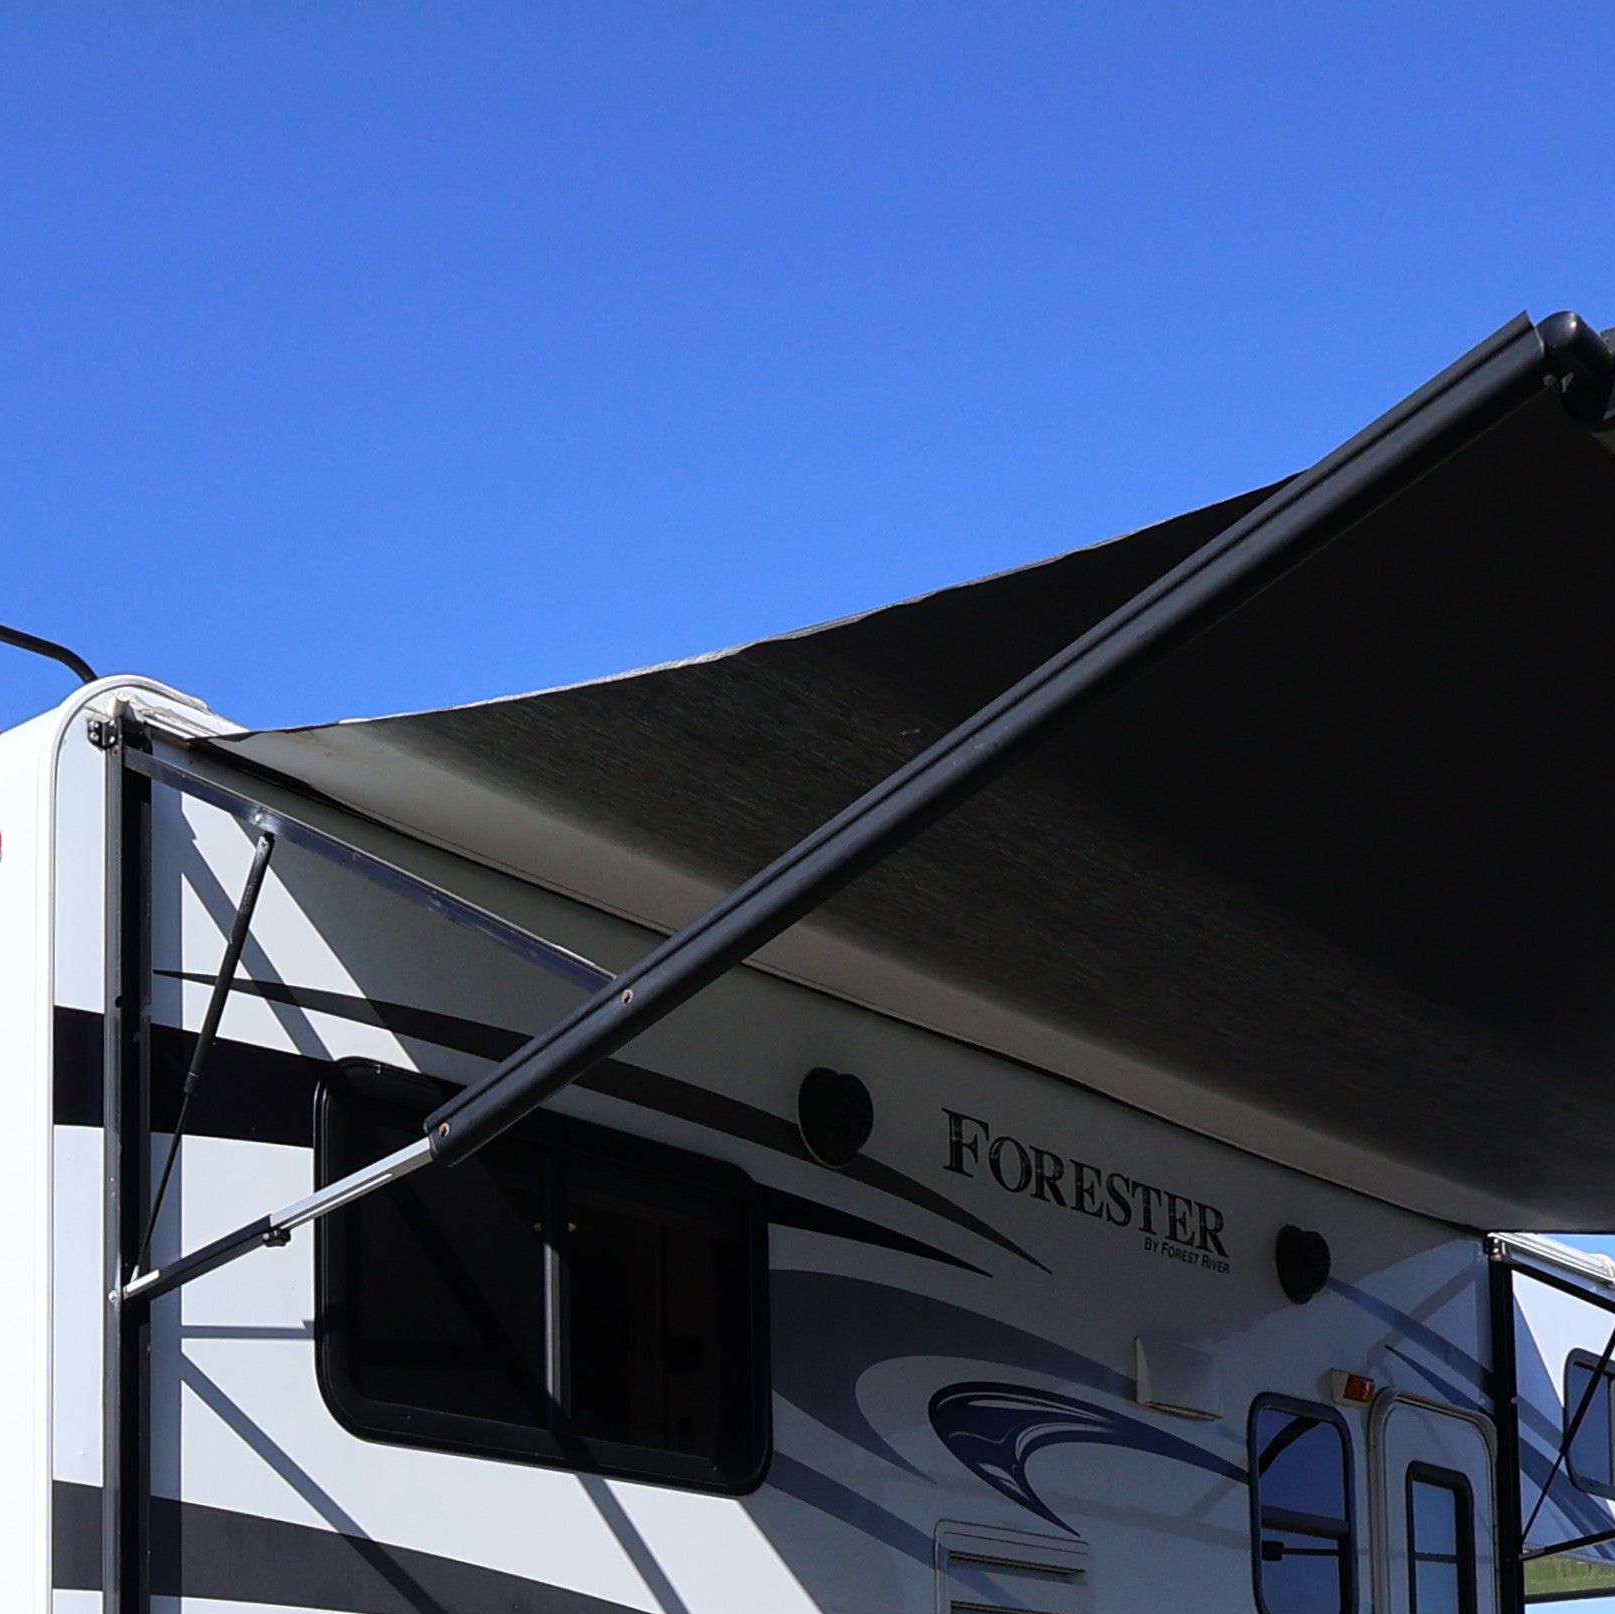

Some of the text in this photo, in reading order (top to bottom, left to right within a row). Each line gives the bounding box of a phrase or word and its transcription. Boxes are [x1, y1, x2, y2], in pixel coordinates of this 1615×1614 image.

[941, 1107, 1229, 1258] FORESTER
[1144, 1237, 1230, 1274] BY FOREST RIVER
